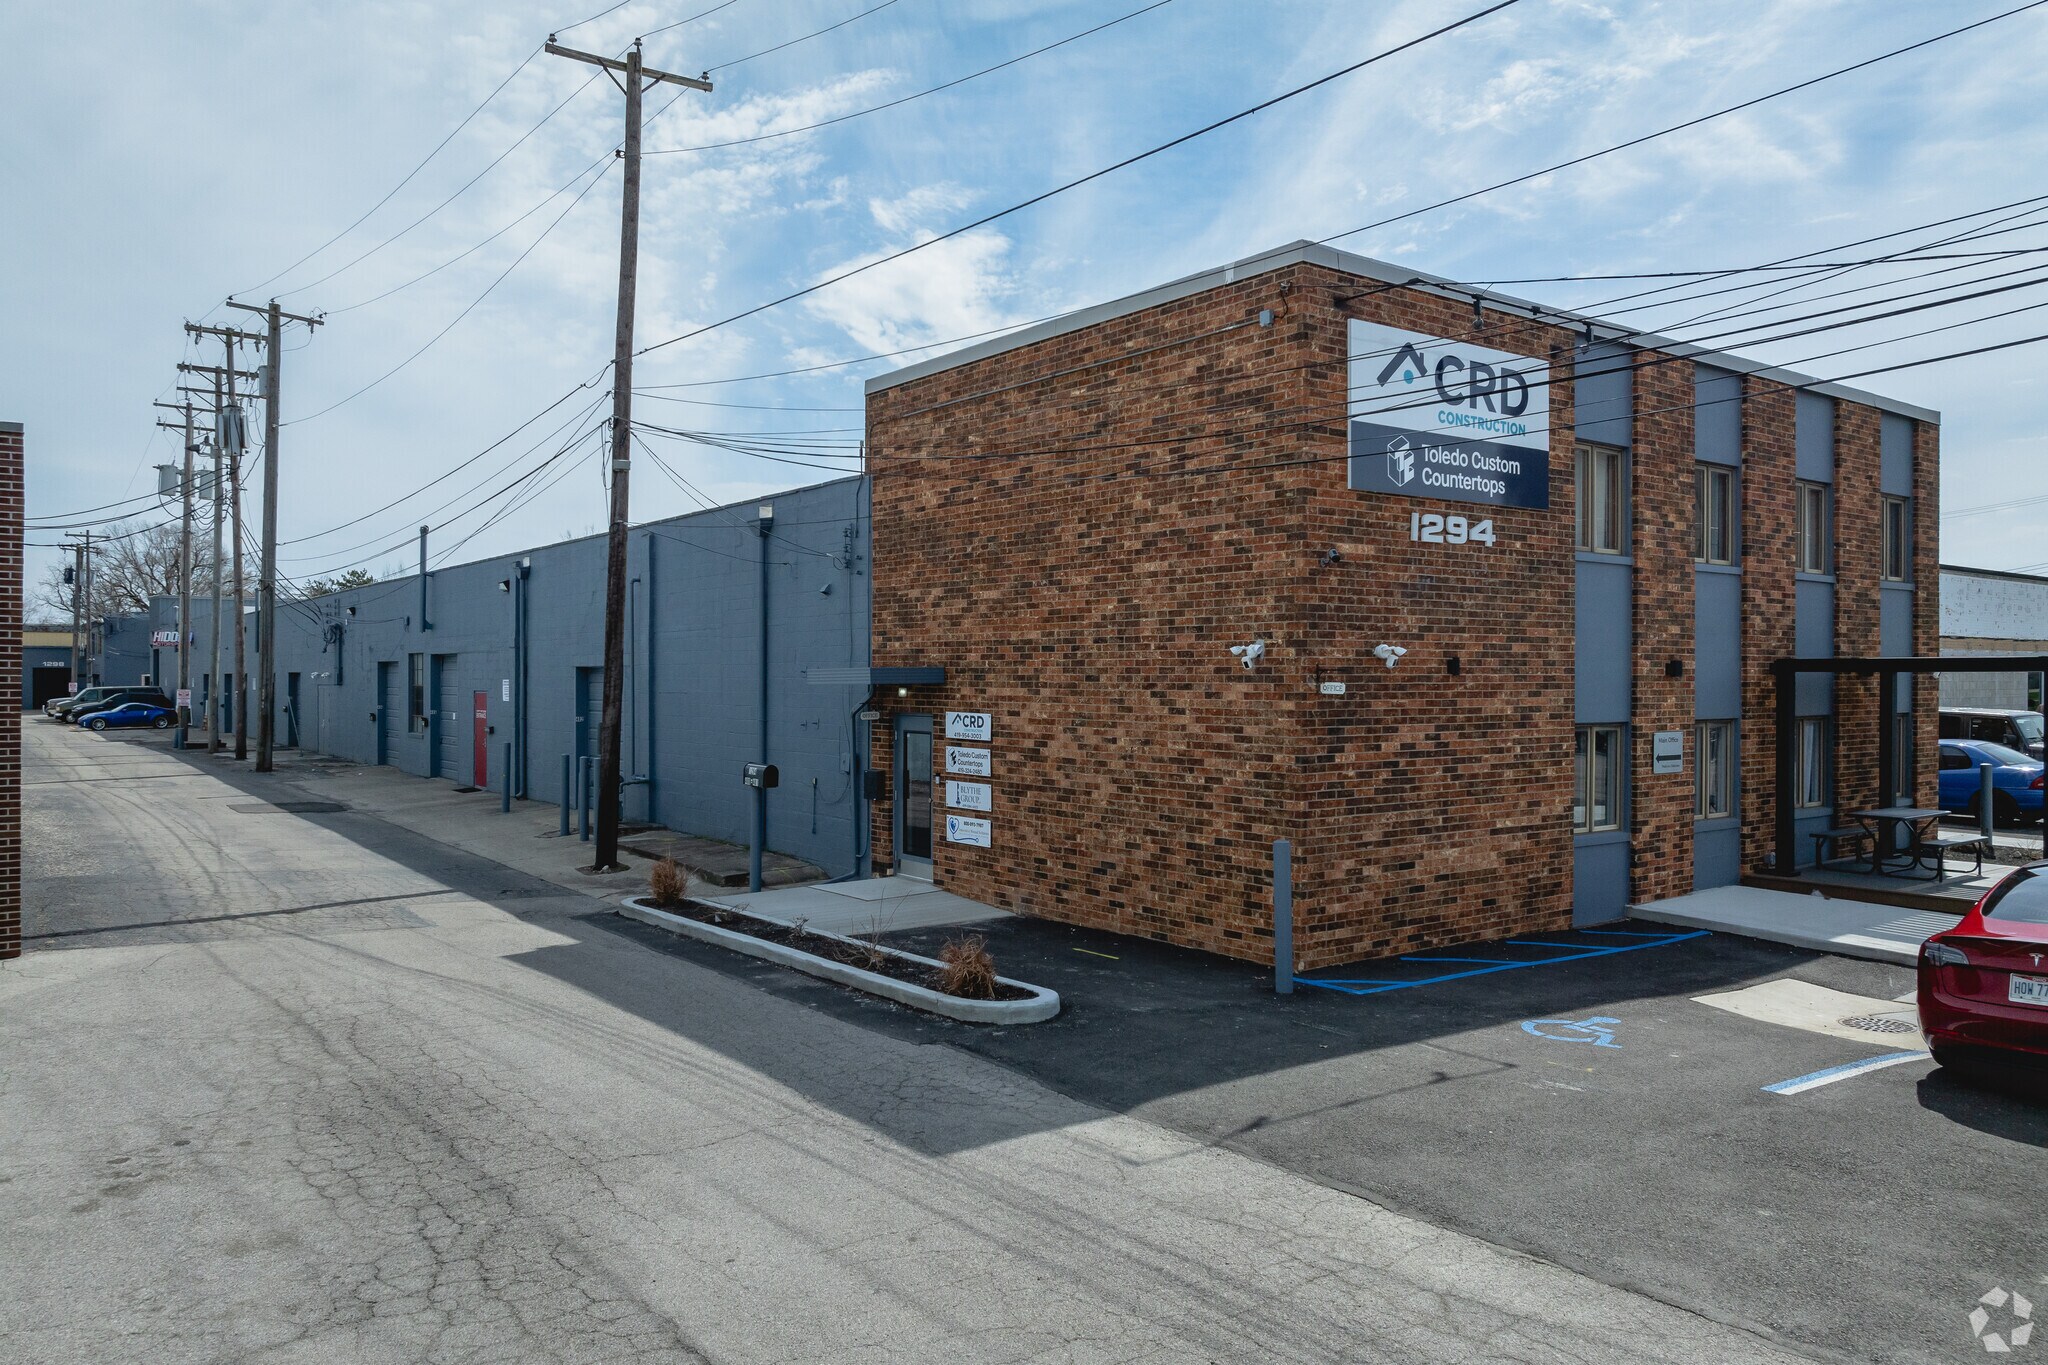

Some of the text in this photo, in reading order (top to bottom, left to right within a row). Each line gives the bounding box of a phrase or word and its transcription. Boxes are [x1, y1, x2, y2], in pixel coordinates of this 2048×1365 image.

[1434, 354, 1529, 418] CRD
[1437, 410, 1526, 437] CONSTRUCTION
[1421, 443, 1521, 475] Toledo Custom
[1421, 467, 1506, 498] Countertops
[1409, 512, 1497, 548] 1294
[1322, 684, 1343, 692] OFFICE
[962, 714, 985, 729] CRD
[953, 732, 982, 740] 419-954-3003
[957, 750, 989, 760] Toledo Custom
[957, 758, 984, 768] Countertops
[960, 785, 982, 796] BLYTHE
[2014, 982, 2034, 994] HOW
